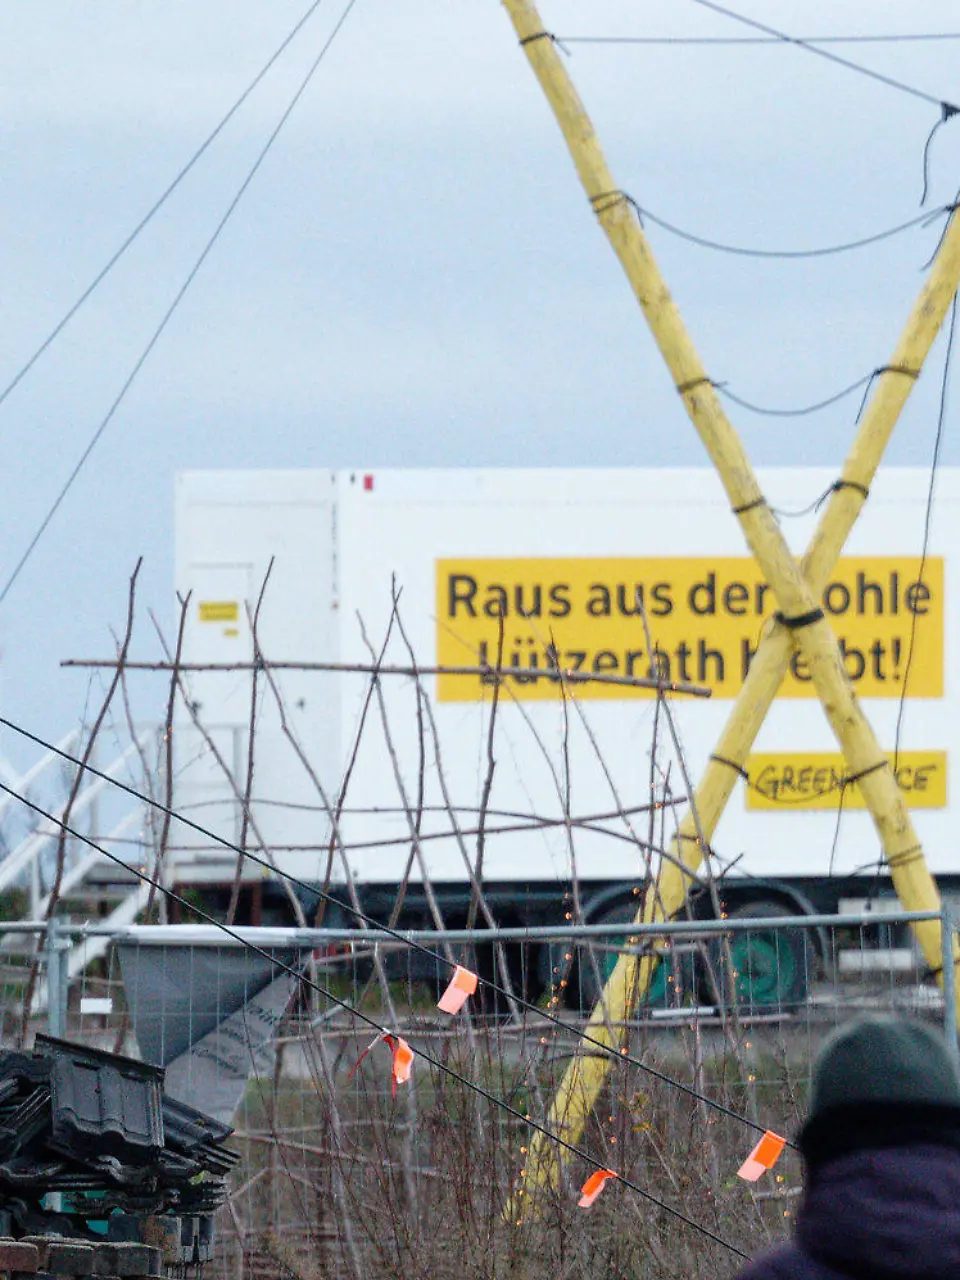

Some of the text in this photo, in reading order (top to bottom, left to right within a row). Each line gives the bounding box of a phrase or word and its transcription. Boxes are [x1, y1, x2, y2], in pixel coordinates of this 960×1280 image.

[448, 571, 931, 618] Raus aus der ohle
[479, 637, 725, 685] Lützerath
[755, 764, 938, 800] GREENCE
